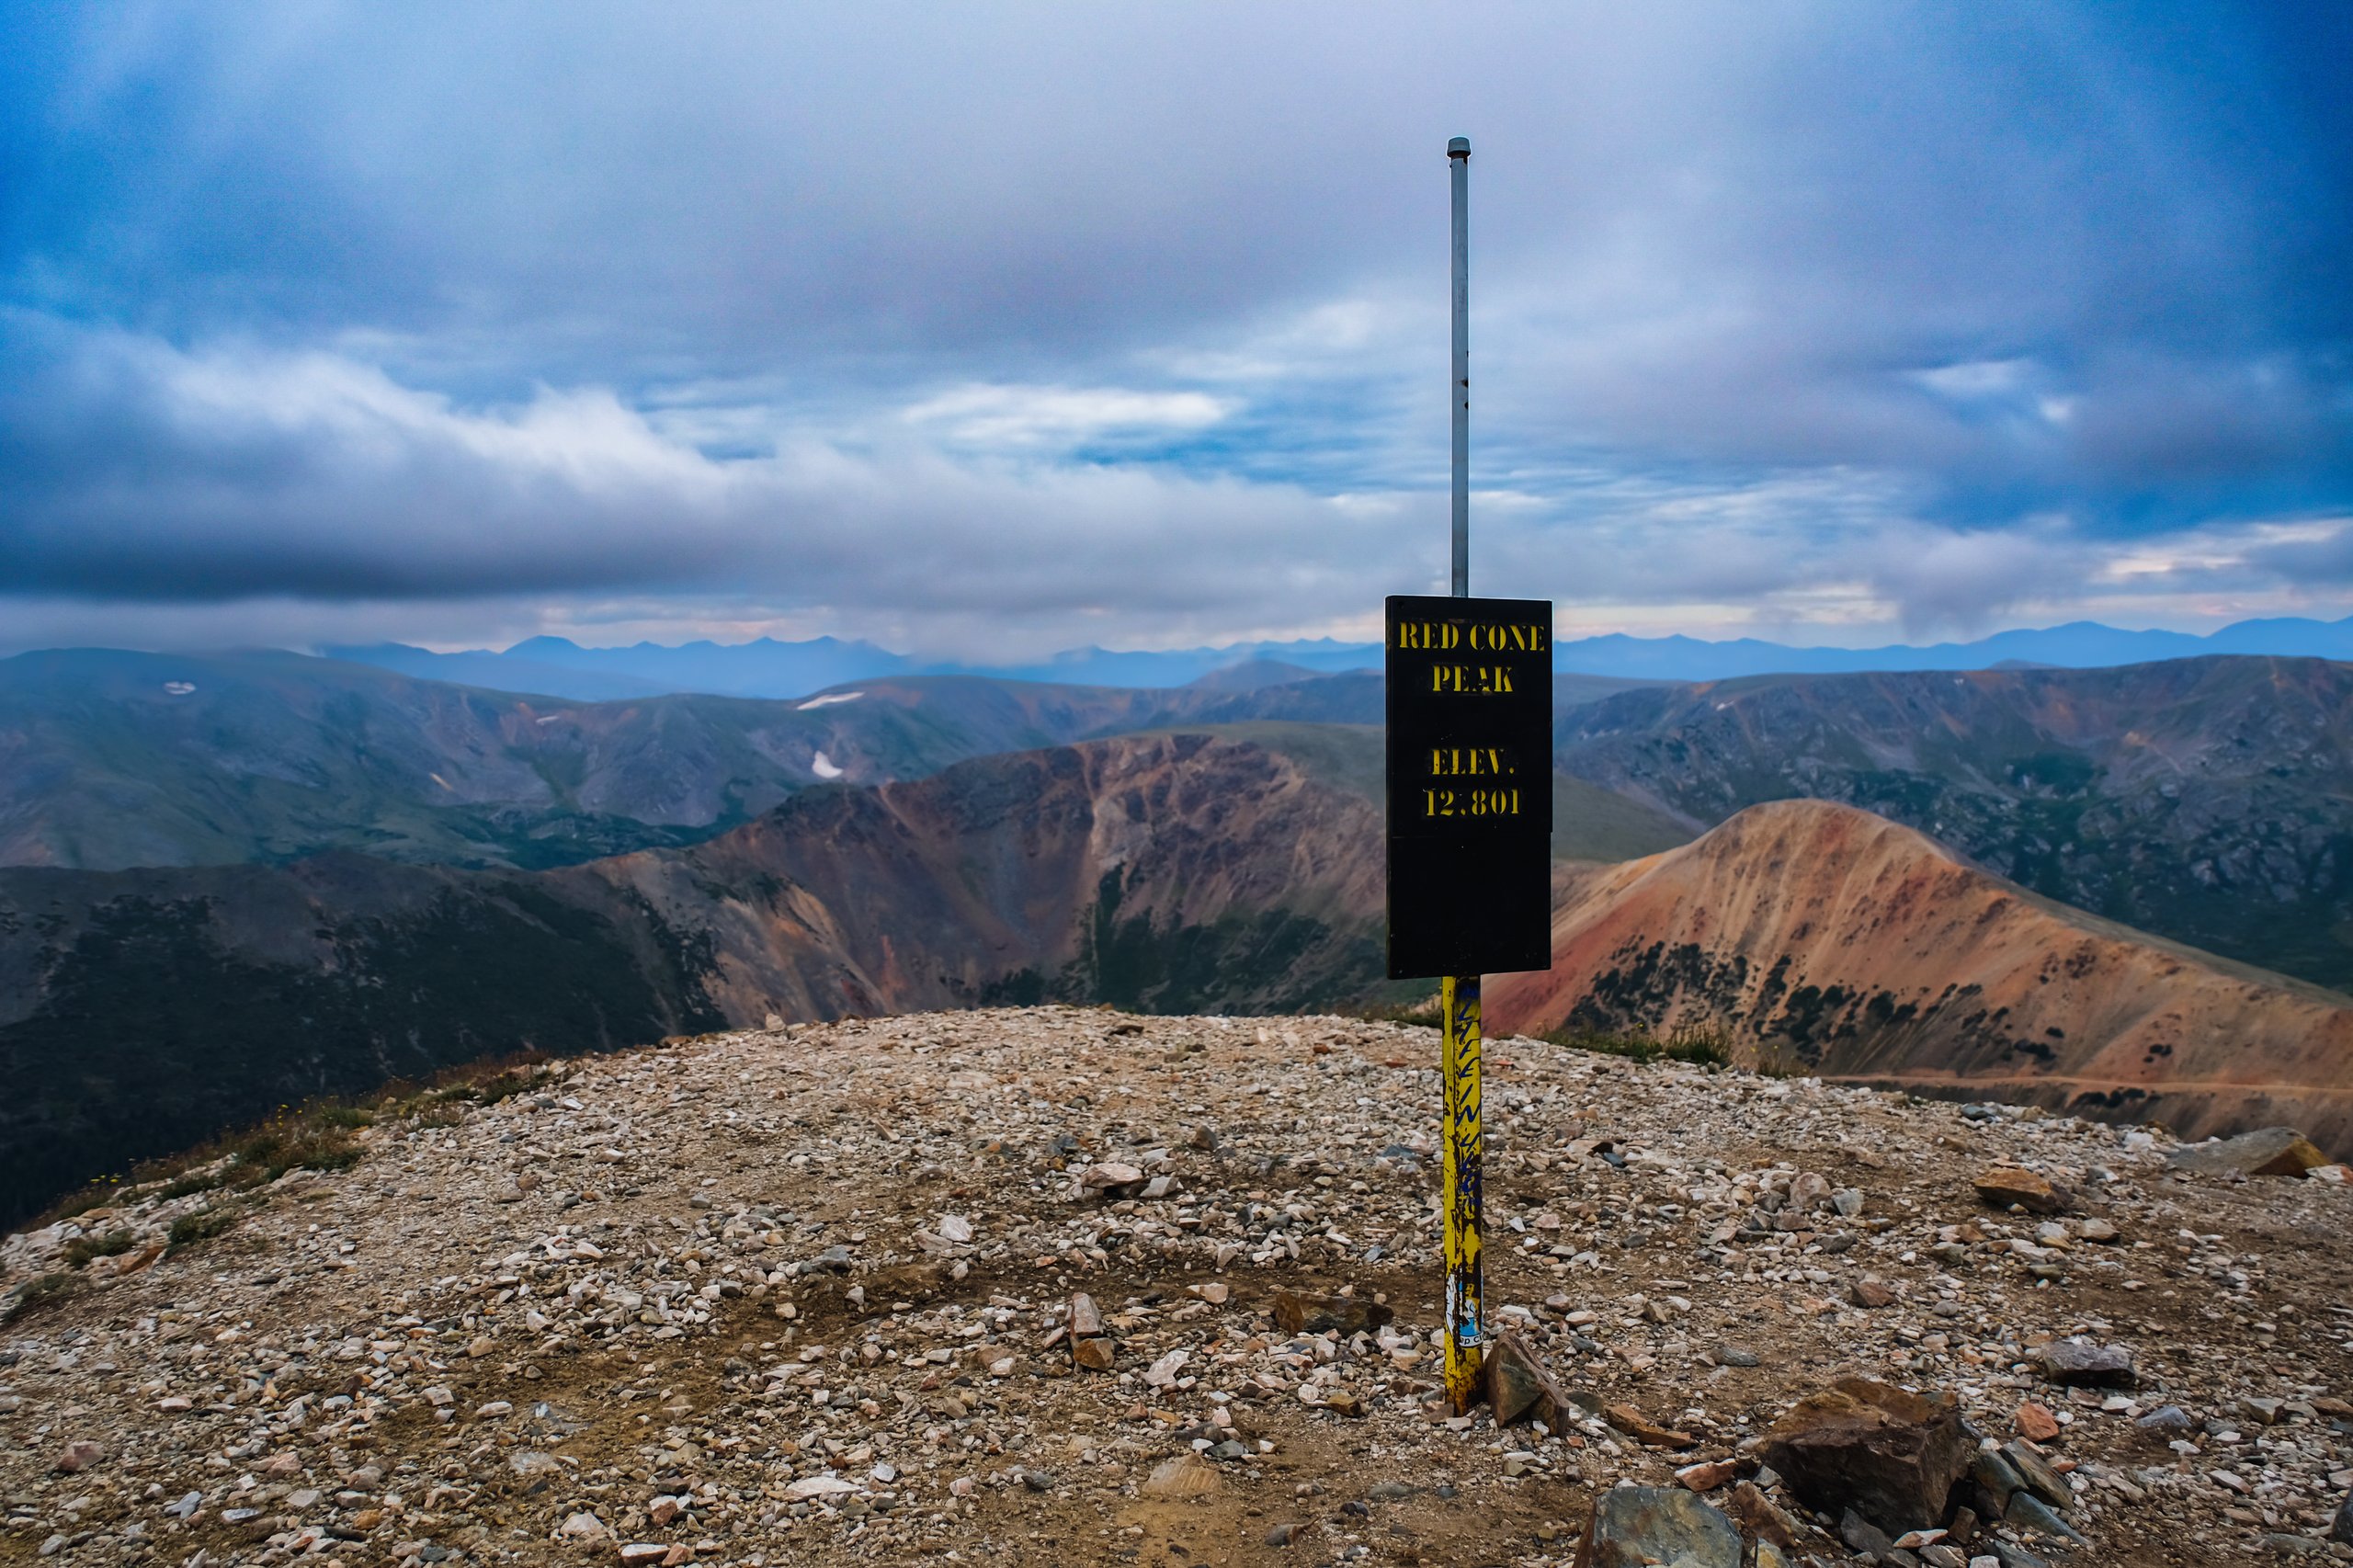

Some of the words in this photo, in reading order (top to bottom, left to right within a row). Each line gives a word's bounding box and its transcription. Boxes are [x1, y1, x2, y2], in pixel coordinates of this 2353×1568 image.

[1399, 621, 1460, 649] RED
[1470, 623, 1545, 652] CONE
[1432, 665, 1514, 692] PEAK
[1432, 748, 1515, 775] ELEV.
[1426, 789, 1519, 816] 12.801
